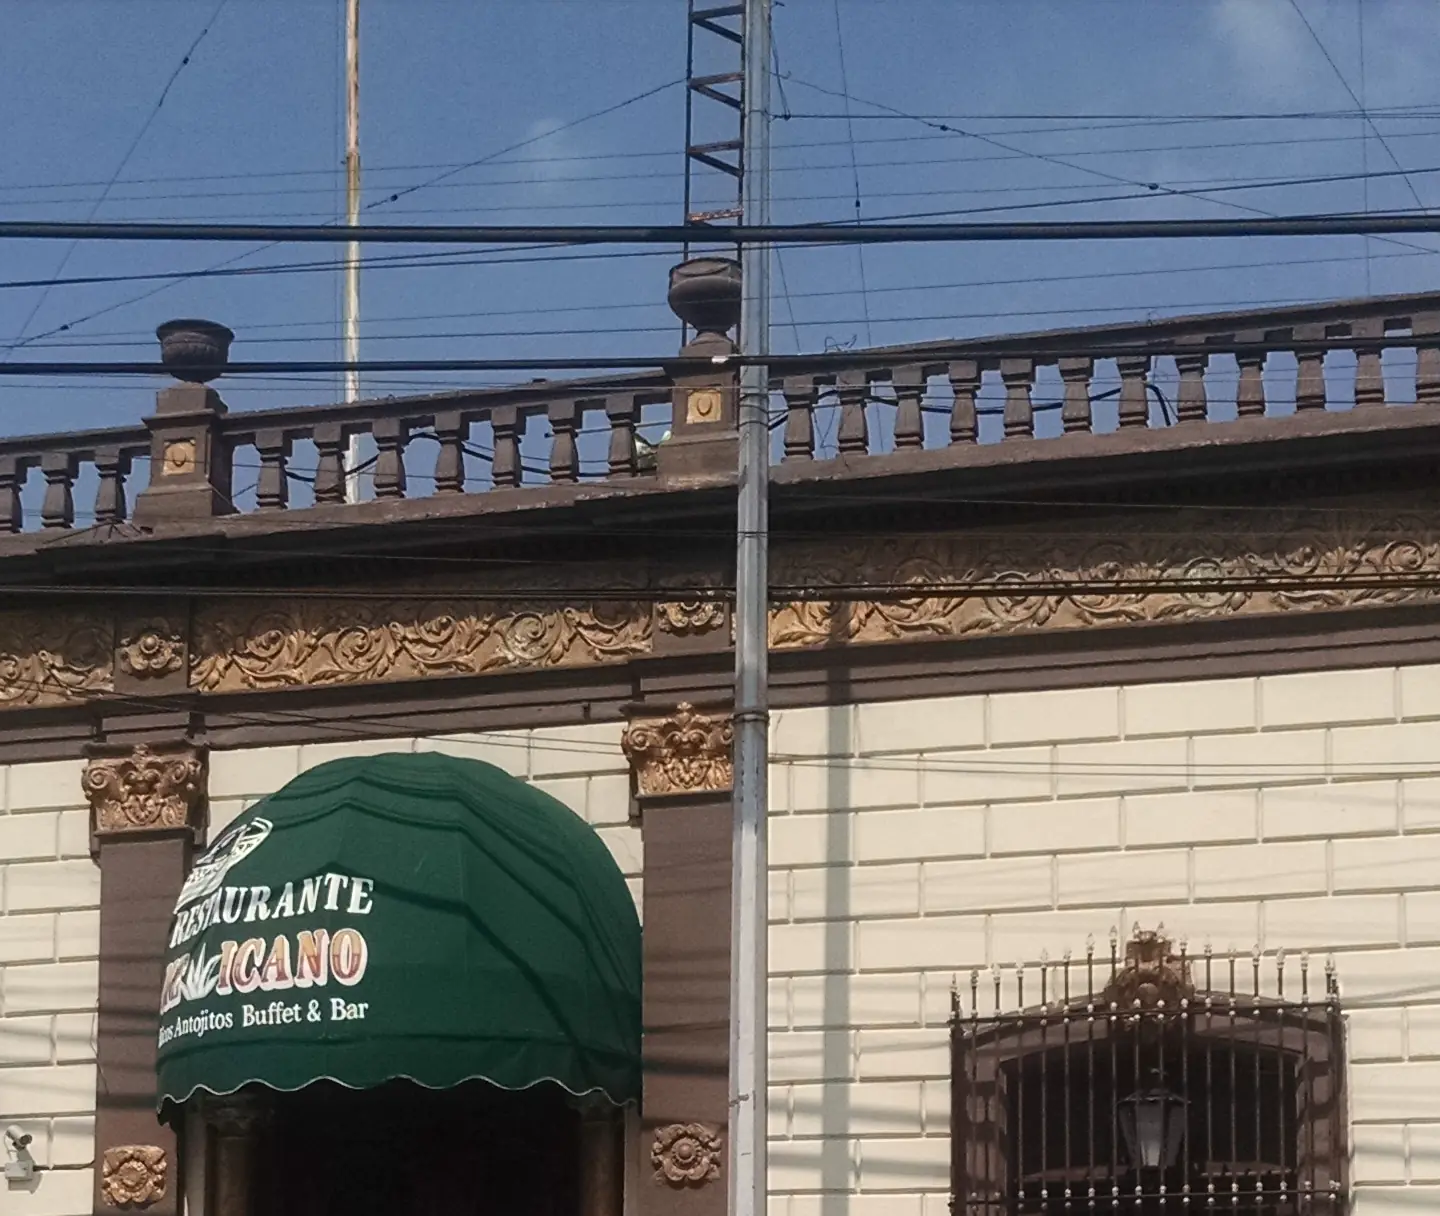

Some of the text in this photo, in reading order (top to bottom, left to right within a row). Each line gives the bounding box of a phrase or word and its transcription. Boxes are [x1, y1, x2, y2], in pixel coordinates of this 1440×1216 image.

[170, 872, 374, 948] RESTAURANTE
[174, 1009, 234, 1038] Antojitos
[242, 1002, 302, 1027] Buffet
[307, 999, 321, 1022] &
[329, 997, 369, 1020] Bar
